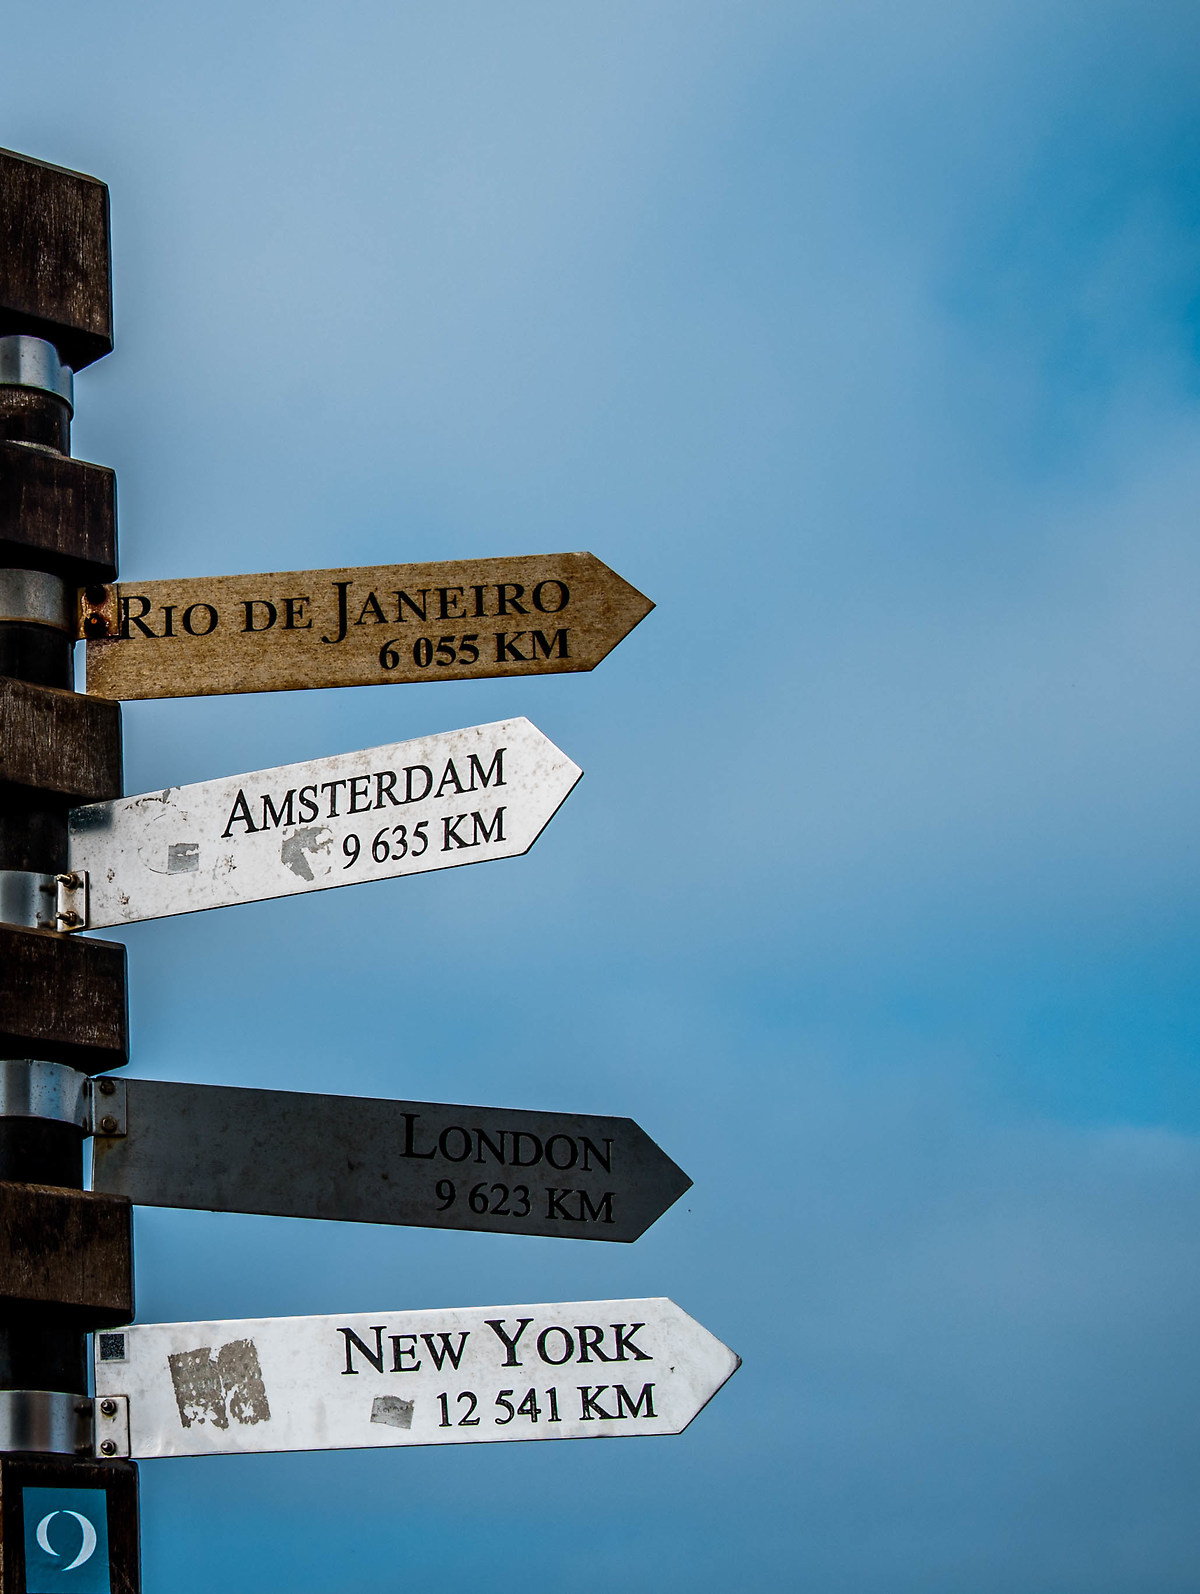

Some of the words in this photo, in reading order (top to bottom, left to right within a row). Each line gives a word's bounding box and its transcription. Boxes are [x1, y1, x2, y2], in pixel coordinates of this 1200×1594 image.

[119, 595, 219, 640] RIO
[241, 596, 313, 634] DE
[321, 579, 572, 645] JANEIRO
[378, 638, 400, 671] 6
[413, 633, 480, 668] 055
[492, 627, 572, 663] KM
[220, 747, 507, 839] AMSTERDAM
[341, 832, 362, 870] 9
[371, 819, 428, 864] 635
[440, 806, 507, 852] KM
[400, 1113, 615, 1174] LONDON
[435, 1179, 456, 1211] 9
[468, 1182, 532, 1217] 623
[546, 1188, 616, 1223] KM
[337, 1326, 471, 1375] NEW
[484, 1317, 653, 1368] YORK
[437, 1388, 481, 1428] 12
[494, 1387, 562, 1425] 541
[577, 1383, 658, 1420] KM
